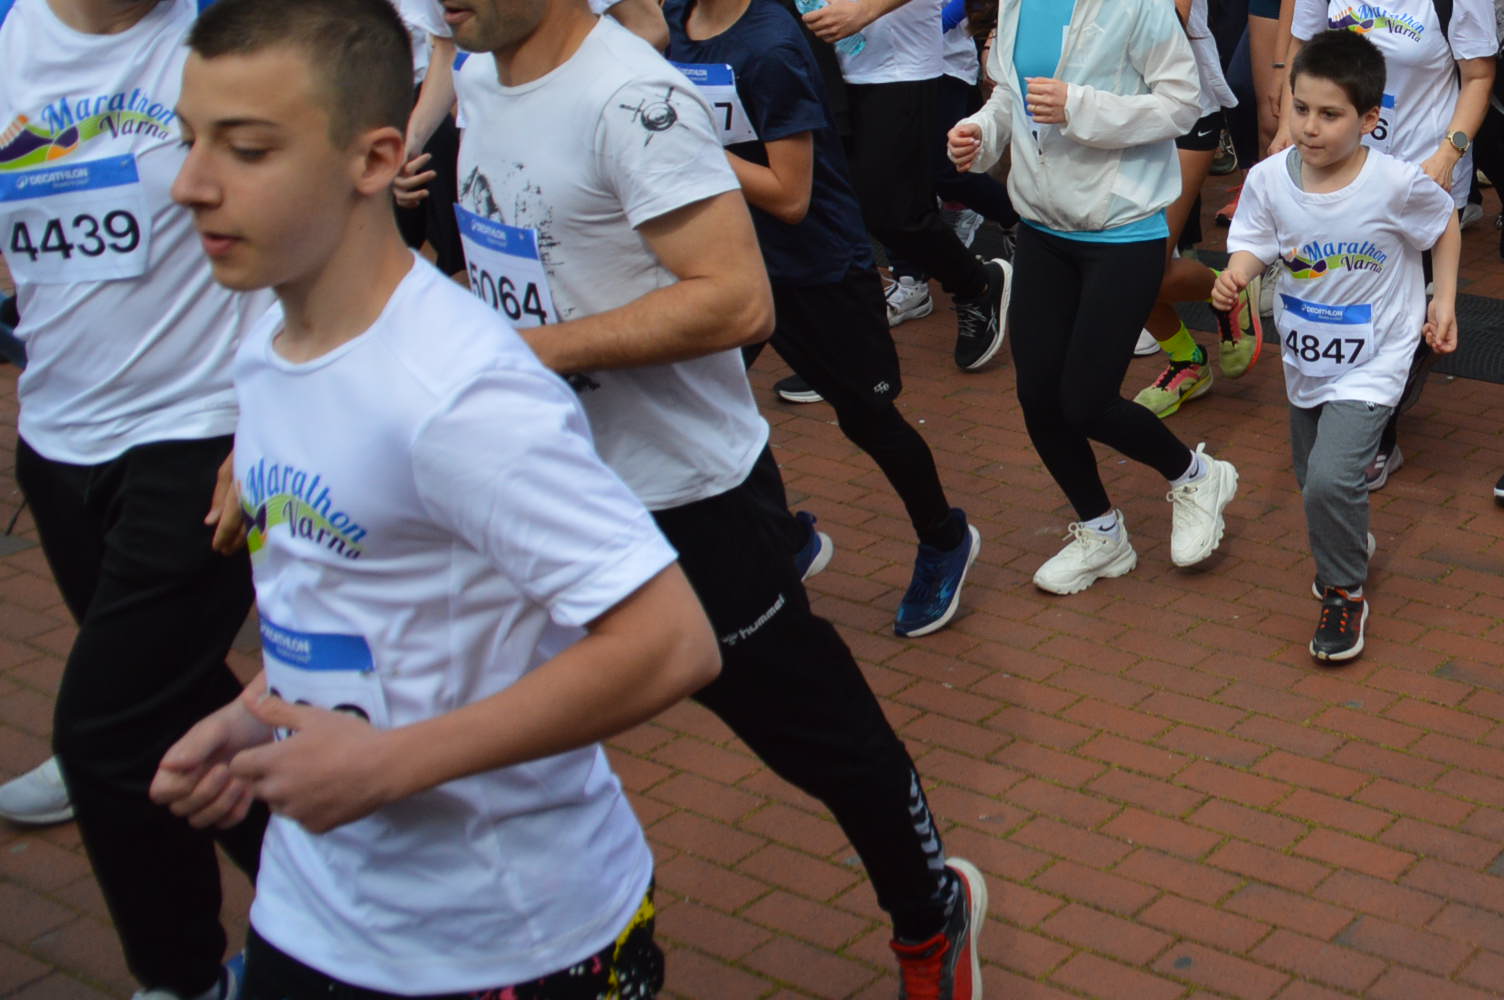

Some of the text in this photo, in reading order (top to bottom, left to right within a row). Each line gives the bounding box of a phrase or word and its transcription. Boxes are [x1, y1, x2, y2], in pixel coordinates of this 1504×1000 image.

[99, 114, 169, 140] Varna
[10, 209, 140, 262] 4439
[1303, 240, 1387, 264] Marathon
[1341, 255, 1384, 274] Varna
[1285, 329, 1365, 365] 4847
[246, 458, 368, 543] Marathon
[282, 499, 361, 560] Varna
[738, 592, 785, 640] hummel
